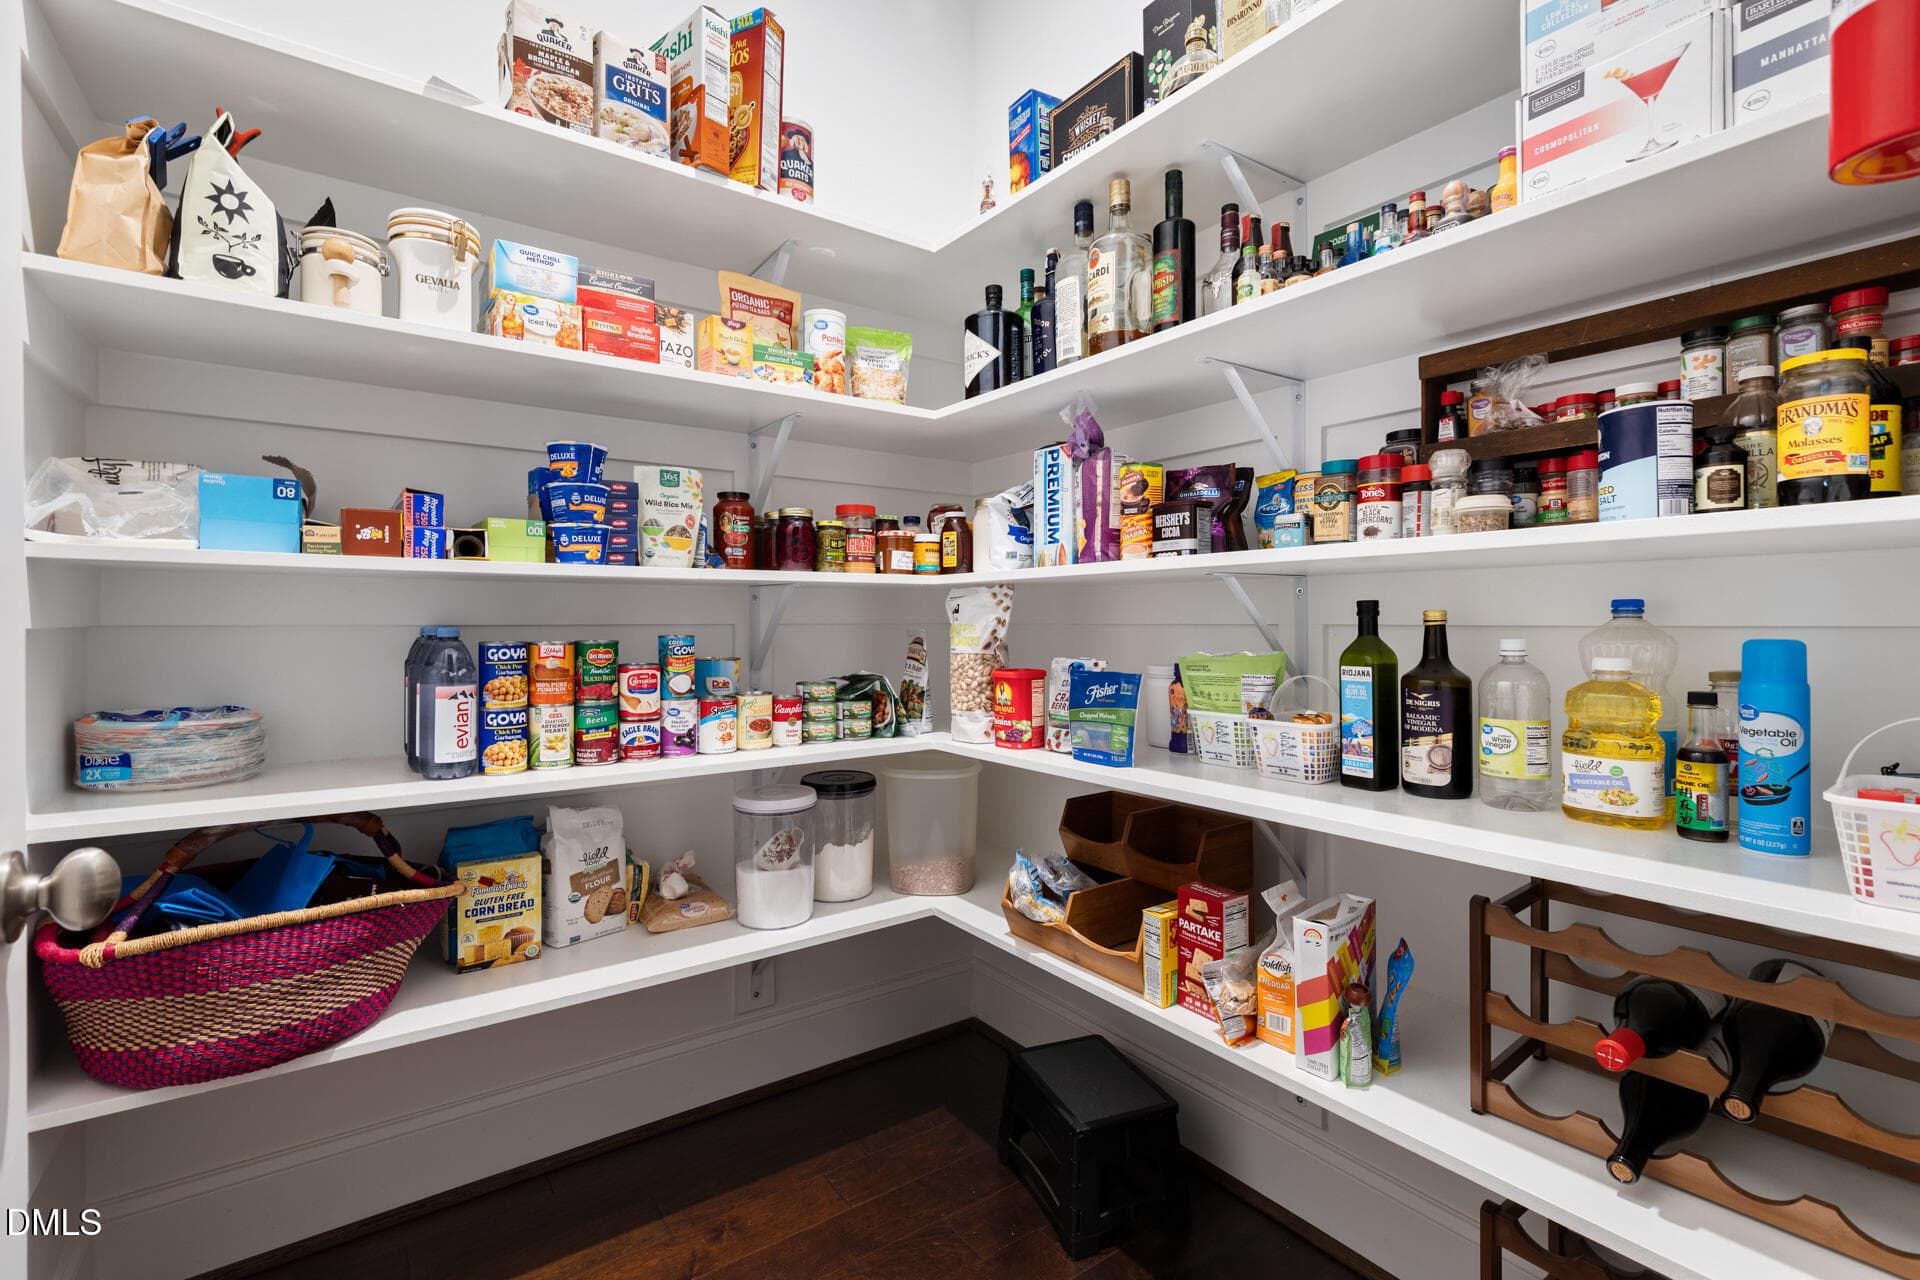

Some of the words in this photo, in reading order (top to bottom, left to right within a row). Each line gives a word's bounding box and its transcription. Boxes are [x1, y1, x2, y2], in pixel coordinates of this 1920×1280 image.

[1541, 4, 1588, 31] COLLECTION
[706, 19, 728, 39] Kashi
[537, 33, 572, 52] QUAKER
[538, 50, 563, 65] MAPLE
[1760, 34, 1827, 67] MANHATTA
[528, 54, 554, 69] BROWN
[557, 63, 580, 76] SUGAR
[623, 61, 651, 77] QUAKER
[625, 72, 651, 88] INSTANT
[613, 76, 660, 106] GRITS
[1534, 84, 1578, 106] BARTESIAN
[624, 96, 651, 112] ORIGINAL
[1074, 111, 1100, 136] WHISKEY
[1534, 122, 1600, 156] COSMOPOLITAN
[780, 160, 813, 177] QUAKER
[789, 168, 808, 182] OATS
[519, 248, 542, 258] QUICK
[542, 253, 560, 263] CHILL
[526, 256, 554, 267] METHOD
[416, 274, 460, 290] GEVALIA
[732, 290, 770, 309] ORGANIC
[528, 317, 542, 326] Iced
[543, 320, 558, 329] Tea
[592, 320, 620, 332] TWININGS
[630, 325, 652, 335] English
[660, 340, 693, 358] TAZO
[764, 354, 790, 364] Assorted
[792, 358, 804, 366] Teas
[1788, 436, 1843, 450] Molasses
[550, 452, 576, 461] DELUXE
[1792, 452, 1834, 464] ORIGINAL
[662, 473, 678, 482] 365
[277, 486, 295, 498] 80
[1048, 448, 1060, 546] PREMIUM
[1180, 488, 1218, 498] GHIRARDELLI
[1361, 488, 1386, 500] Tone's
[422, 495, 430, 512] Wrap
[645, 499, 662, 508] Wild
[663, 500, 680, 508] Rice
[681, 502, 694, 510] Mix
[430, 497, 439, 526] Reynolds
[1155, 512, 1190, 528] HERSHEY'S
[422, 529, 431, 547] Wrap
[528, 526, 544, 536] 100
[1162, 526, 1180, 538] COCOA
[572, 534, 602, 544] DELUXE
[488, 648, 528, 660] GOYA
[1342, 669, 1370, 678] RIOJANA
[629, 676, 658, 686] Carnation
[712, 680, 730, 688] Dole
[1085, 682, 1119, 704] Fisher
[486, 713, 528, 725] GOYA
[1080, 712, 1098, 720] Chopped
[1406, 712, 1440, 721] BALSAMIC
[1407, 718, 1438, 727] VINEGAR
[454, 701, 470, 749] evian
[622, 725, 642, 738] EAGLE
[643, 724, 660, 736] BRAND
[1411, 724, 1443, 734] MODENA
[1491, 736, 1512, 744] White
[1740, 726, 1796, 741] Vegetable
[1484, 740, 1512, 751] Vinegar
[1780, 738, 1798, 748] Oil
[85, 756, 120, 766] Dixie
[86, 770, 102, 780] 2X
[1574, 778, 1610, 786] VEGETABLE
[470, 882, 502, 896] Famous
[584, 875, 612, 890] FLOUR
[474, 896, 504, 907] GLUTEN
[505, 892, 526, 902] FREE
[464, 905, 494, 919] CORN
[498, 898, 535, 913] BREAD
[1178, 917, 1222, 942] PARTAKE
[1261, 956, 1292, 974] Goldfish
[1258, 976, 1290, 990] CHEDDAR
